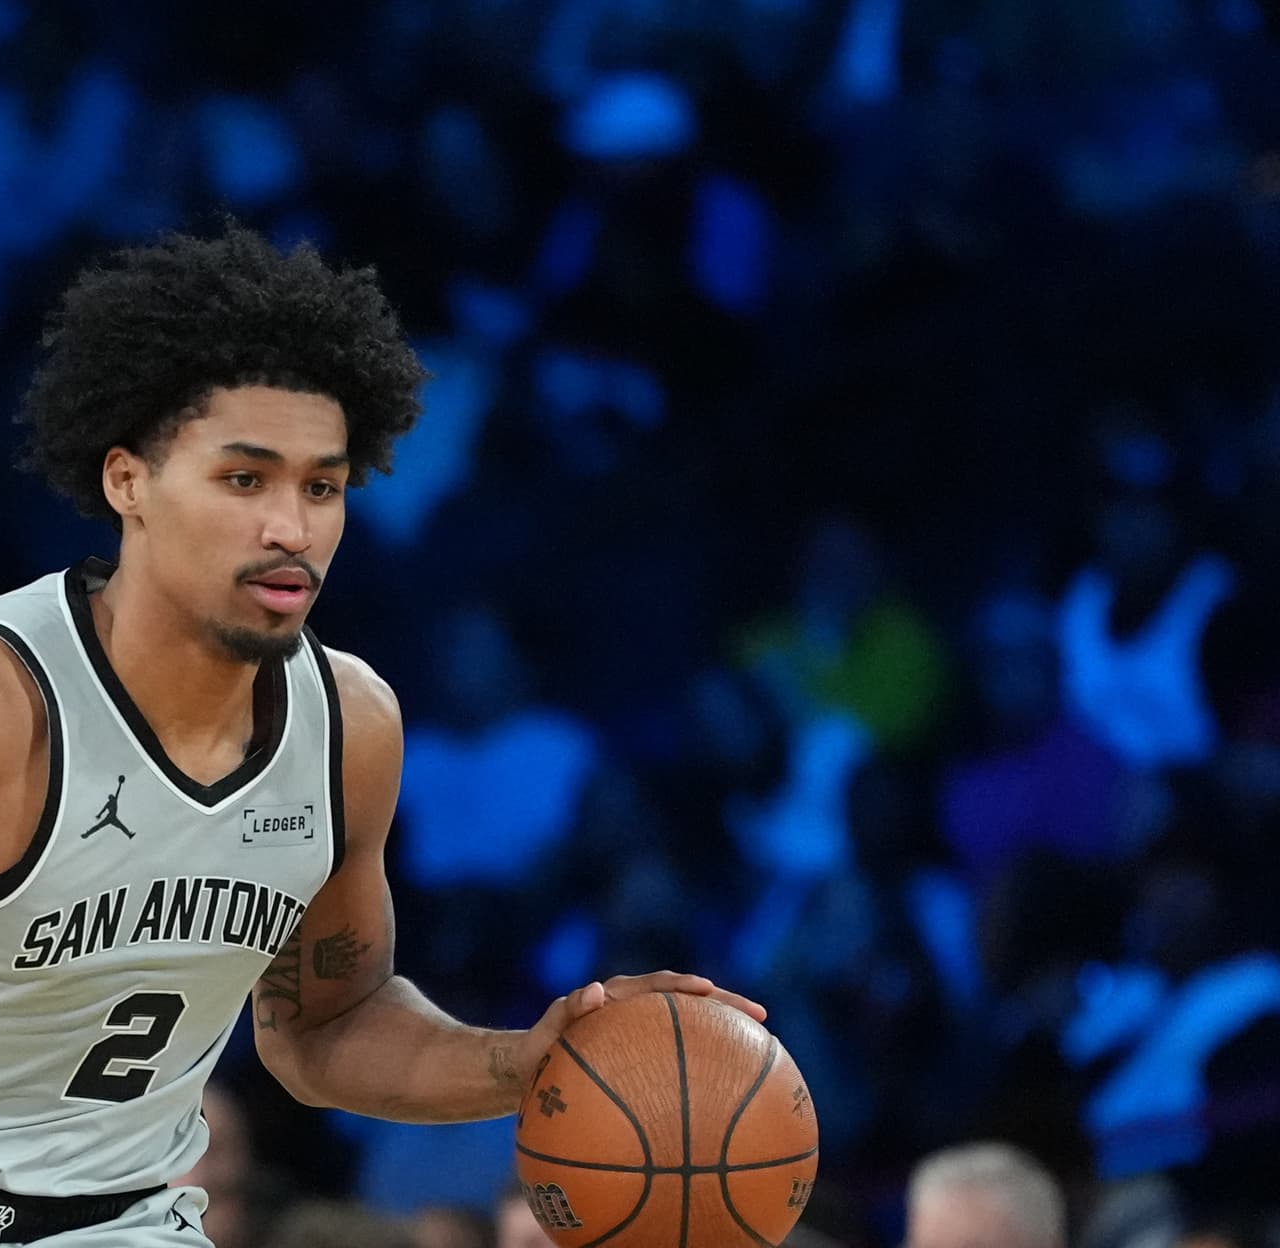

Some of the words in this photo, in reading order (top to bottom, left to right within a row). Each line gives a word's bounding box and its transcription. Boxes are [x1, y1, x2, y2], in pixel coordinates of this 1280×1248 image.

[253, 815, 306, 833] LEDGER
[12, 884, 130, 971] SAN
[60, 990, 190, 1108] 2
